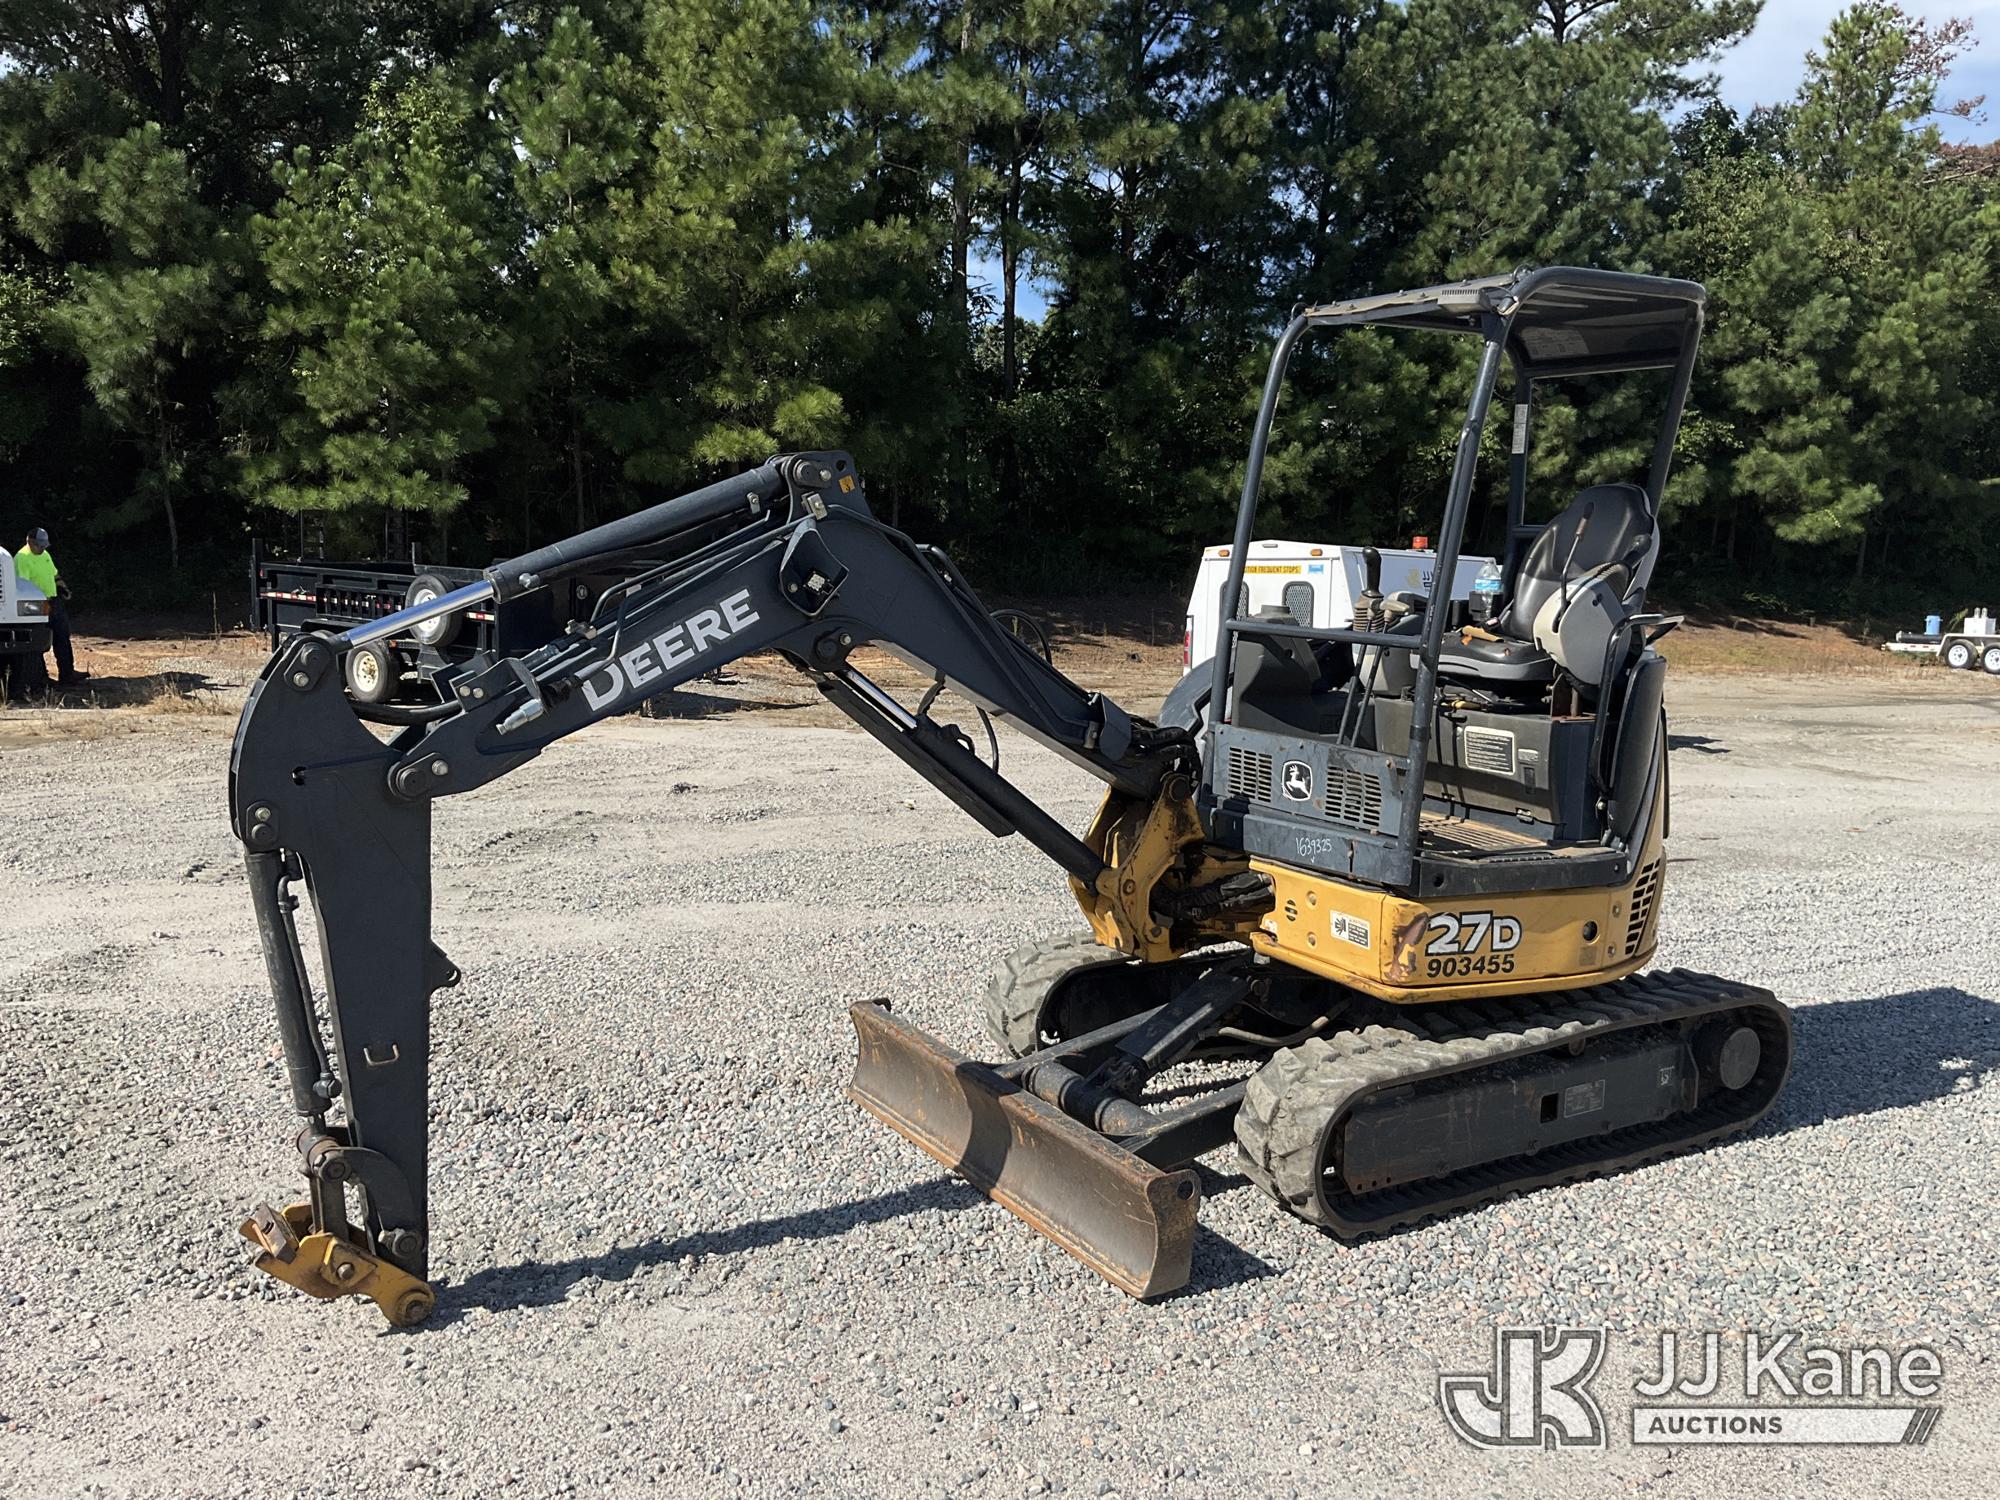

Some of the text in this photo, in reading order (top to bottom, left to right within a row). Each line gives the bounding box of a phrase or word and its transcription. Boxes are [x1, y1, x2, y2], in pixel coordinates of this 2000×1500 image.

[581, 588, 760, 711] DEERE
[1295, 837, 1332, 857] 1639325
[1425, 910, 1522, 956] 27D
[1426, 954, 1515, 978] 903455
